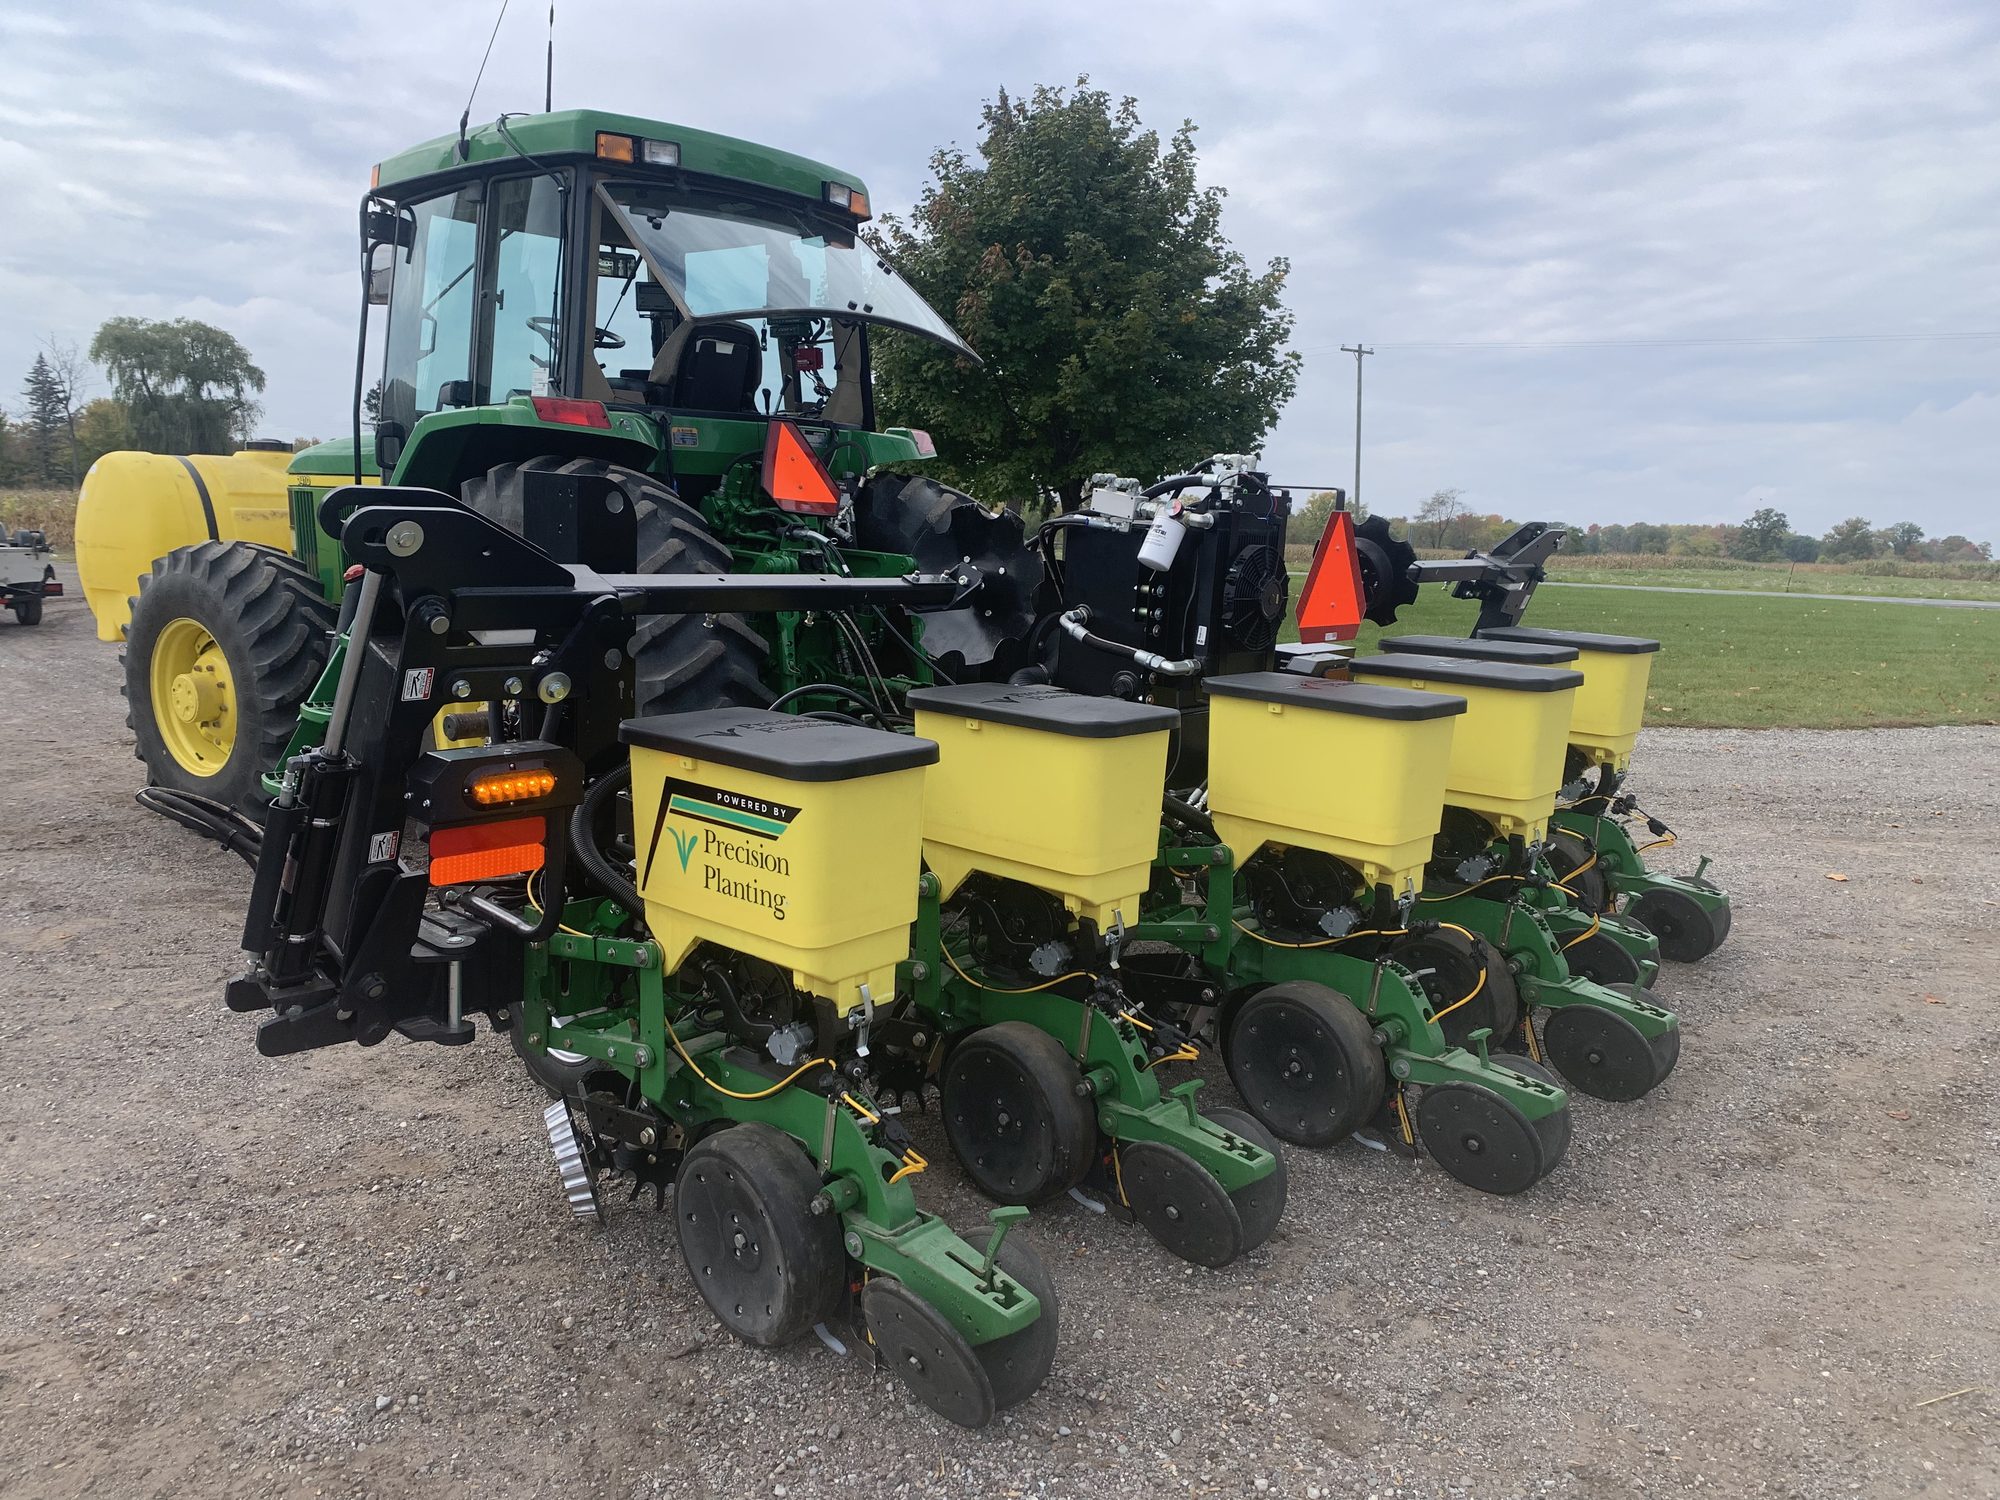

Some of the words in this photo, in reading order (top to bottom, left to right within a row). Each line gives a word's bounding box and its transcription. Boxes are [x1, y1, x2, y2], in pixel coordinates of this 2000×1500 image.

[717, 792, 768, 813] POWERED
[773, 807, 787, 818] BY
[703, 828, 790, 877] Precision
[703, 863, 786, 921] Planting
